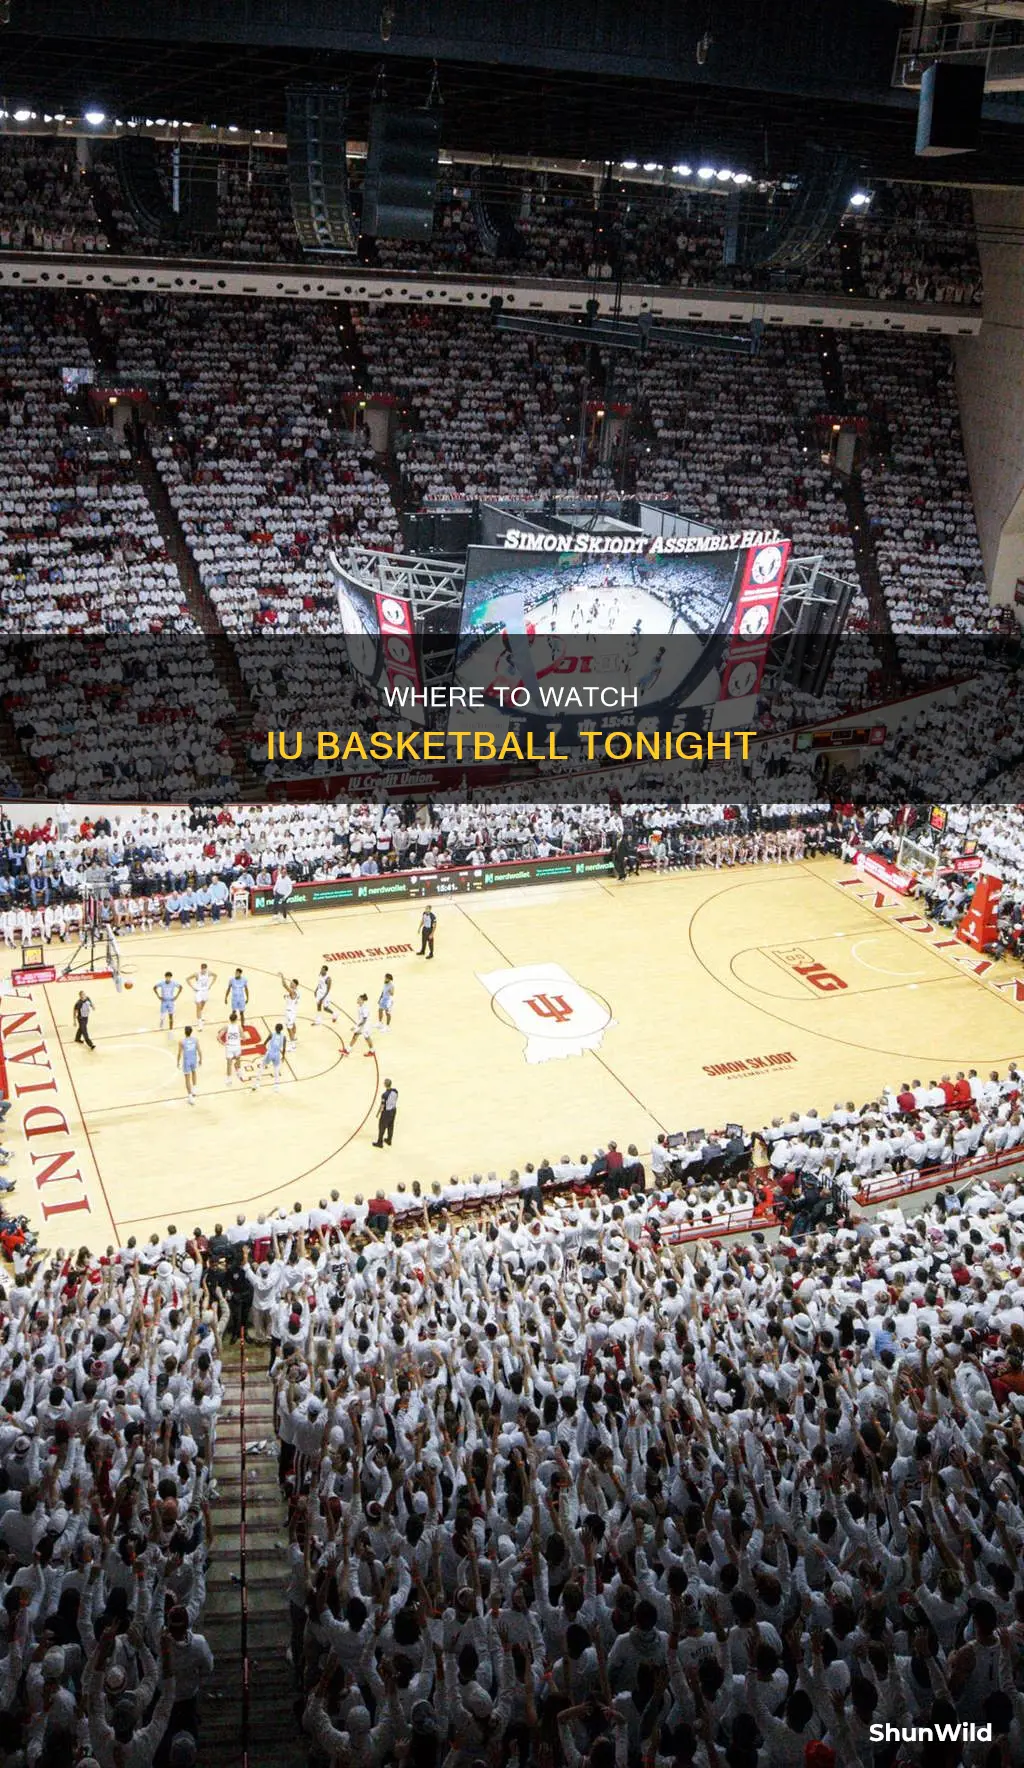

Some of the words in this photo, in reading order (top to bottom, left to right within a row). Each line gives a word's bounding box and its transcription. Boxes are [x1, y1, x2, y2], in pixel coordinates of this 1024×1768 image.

[504, 529, 574, 551] SIMON
[574, 533, 649, 553] SKJODT
[649, 533, 741, 553] ASSEMBLY
[740, 528, 783, 548] HALL
[601, 715, 636, 728] 15:41
[348, 776, 361, 789] IU
[363, 773, 398, 788] Credit
[401, 772, 434, 785] Union
[494, 871, 530, 881] nerdwallet
[368, 883, 407, 895] nerdwallet
[322, 950, 366, 962] SIMON
[365, 943, 415, 957] SKJODT
[702, 1060, 749, 1077] SIMON
[745, 1051, 798, 1069] SKJODT
